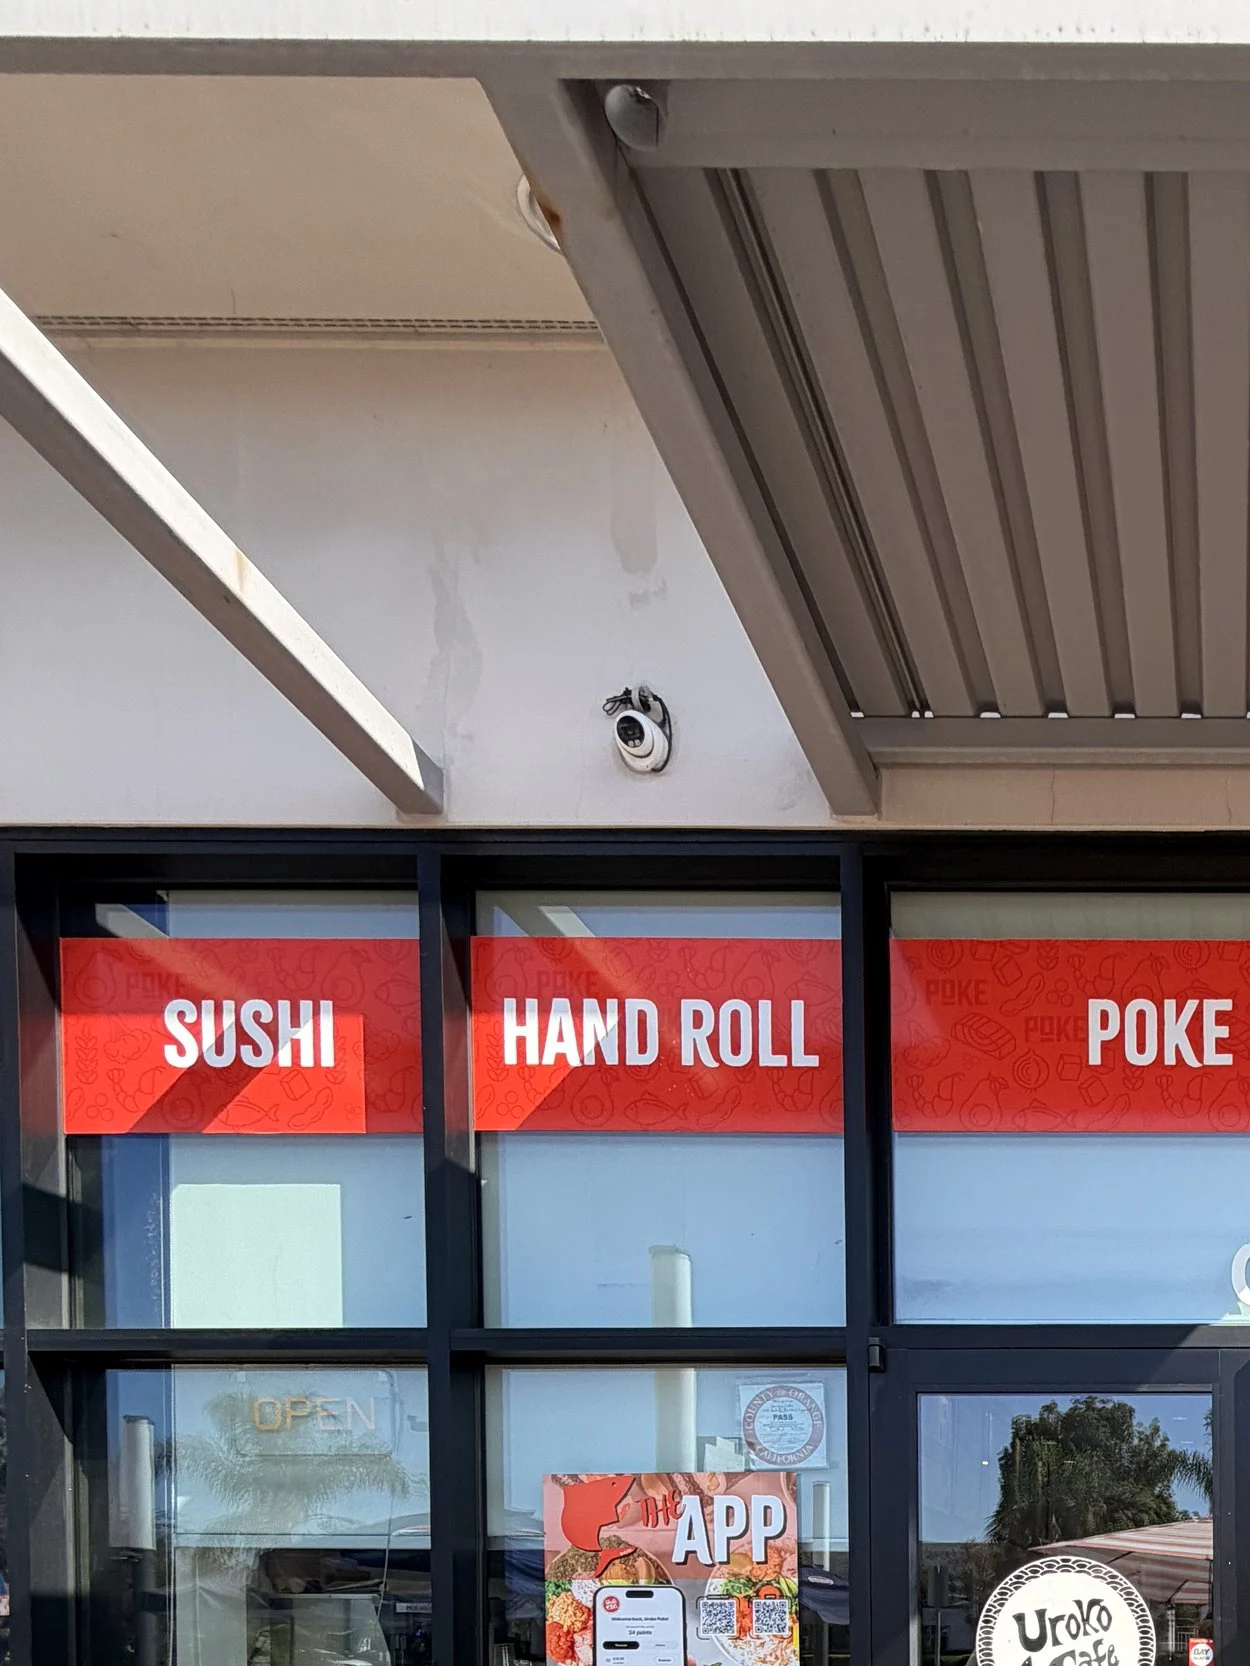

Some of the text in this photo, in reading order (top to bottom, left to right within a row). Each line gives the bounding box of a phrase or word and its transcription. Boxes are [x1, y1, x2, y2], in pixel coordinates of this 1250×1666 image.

[925, 979, 989, 1006] POKE
[163, 999, 335, 1069] SUSHI
[503, 997, 820, 1068] HAND ROLL
[1024, 1016, 1087, 1044] POKE
[1087, 998, 1234, 1069] POKE
[251, 1396, 376, 1432] OPEN
[745, 1390, 774, 1430] COUNTY
[789, 1388, 822, 1428] ORANGE
[772, 1413, 794, 1421] PASS
[756, 1444, 814, 1464] CALIFORNIA
[634, 1489, 687, 1529] THE
[672, 1494, 787, 1567] APP
